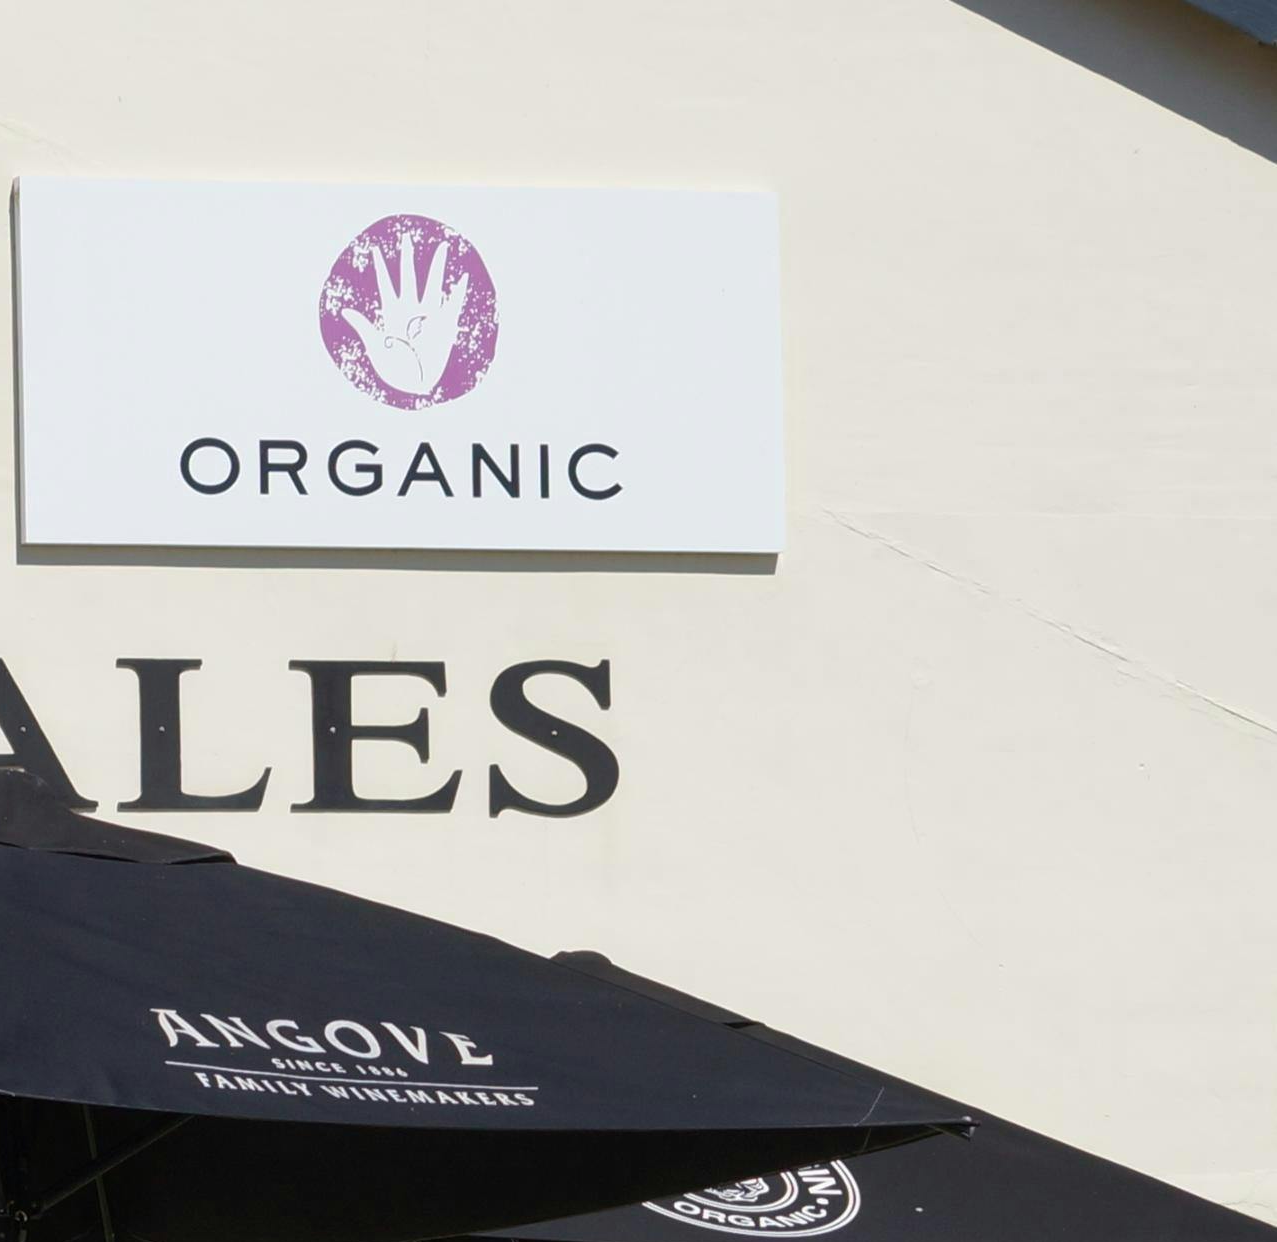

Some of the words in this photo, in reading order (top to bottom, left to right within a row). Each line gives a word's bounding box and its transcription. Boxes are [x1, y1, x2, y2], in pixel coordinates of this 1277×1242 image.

[179, 437, 623, 501] ORGANIC
[150, 1007, 494, 1066] ANGOVE
[271, 1057, 346, 1075] SINCE
[355, 1063, 409, 1078] 1886
[194, 1071, 313, 1097] FAMILY
[320, 1083, 535, 1107] WINEMAKERS
[673, 1201, 827, 1229] ORGANIC
